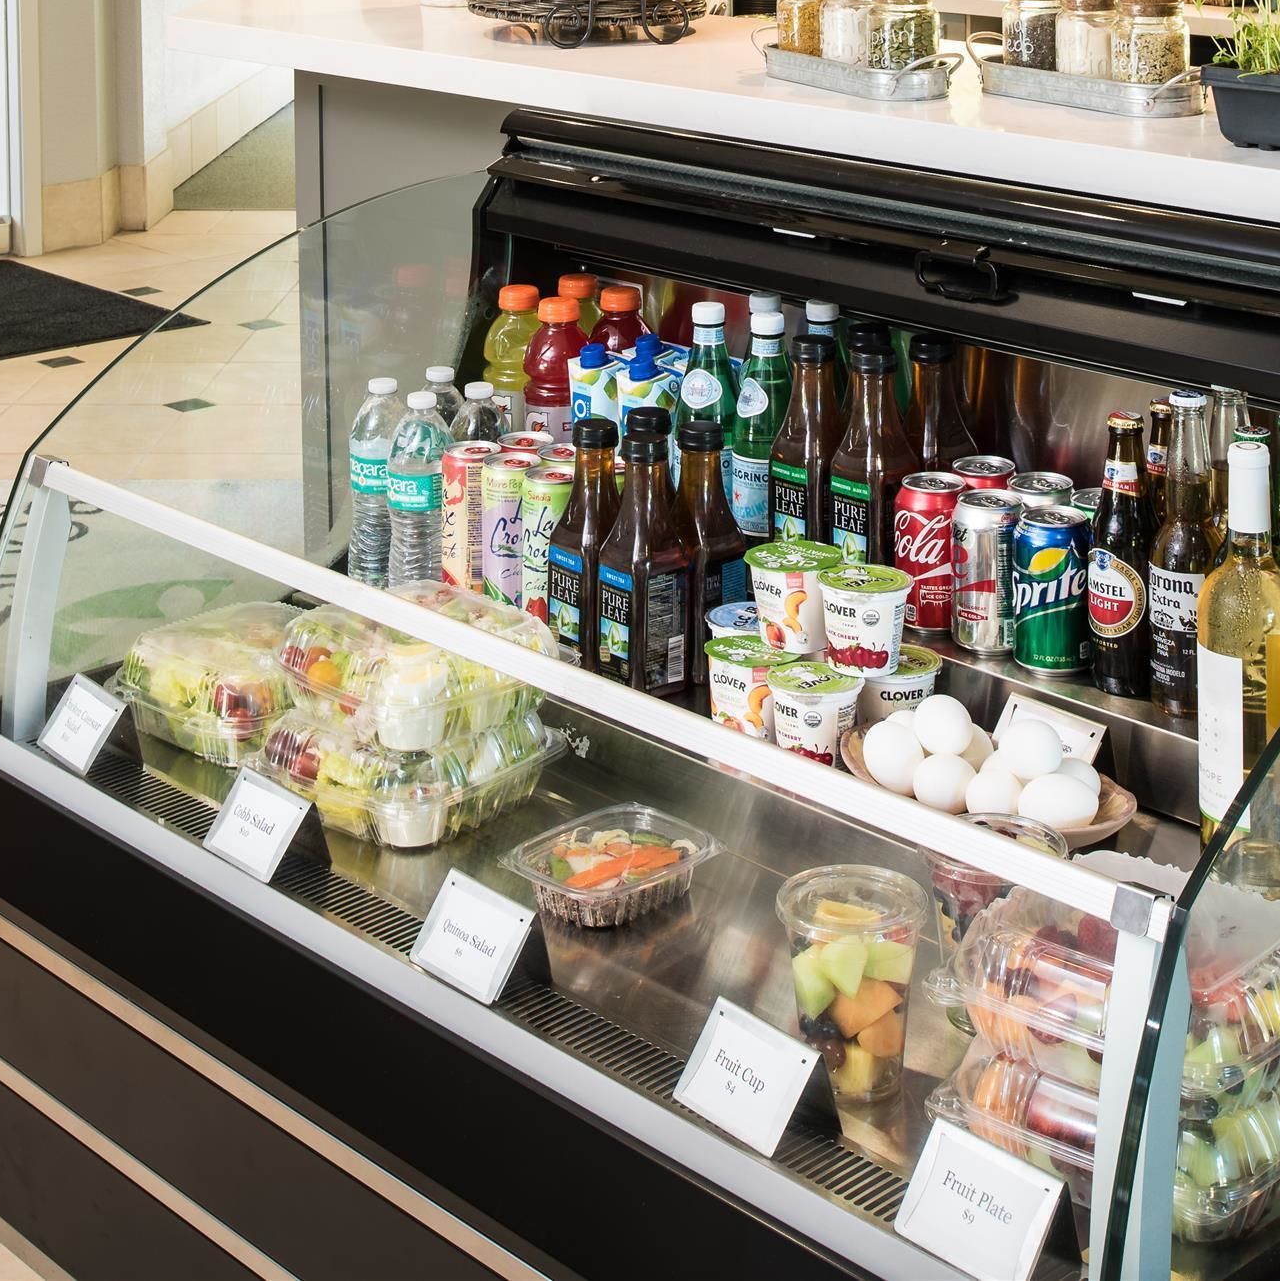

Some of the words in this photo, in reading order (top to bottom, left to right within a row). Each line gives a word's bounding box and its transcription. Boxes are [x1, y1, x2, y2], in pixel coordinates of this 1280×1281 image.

[775, 486, 805, 505] PURE
[775, 498, 803, 518] LEAF
[834, 501, 866, 521] PURE
[834, 514, 864, 534] LEAF
[551, 571, 580, 593] PURE
[1115, 562, 1138, 582] LAGER
[551, 585, 577, 606] LEAF
[754, 580, 782, 598] CLOVER
[1011, 562, 1088, 615] Sprite
[1089, 576, 1125, 597] AMSTEL
[602, 590, 629, 611] PURE
[1090, 593, 1120, 612] LIGHT
[1151, 587, 1181, 609] Extra
[601, 603, 627, 624] LEAF
[824, 599, 857, 618] CLOVER
[1153, 634, 1175, 647] CERVEZA
[1158, 630, 1166, 638] LA
[1156, 648, 1169, 657] FINA
[713, 672, 746, 693] CLOVER
[880, 689, 924, 702] CLOVER
[233, 803, 251, 822] Cobb
[250, 813, 276, 836] Salad
[442, 918, 470, 943] Quinoa
[469, 934, 497, 958] Salad
[714, 1048, 742, 1077] Fruit
[741, 1067, 765, 1094] Cup
[725, 1080, 737, 1096] $4
[942, 1169, 977, 1203] Fruit
[977, 1190, 1013, 1225] Plate
[961, 1209, 976, 1226] $9
